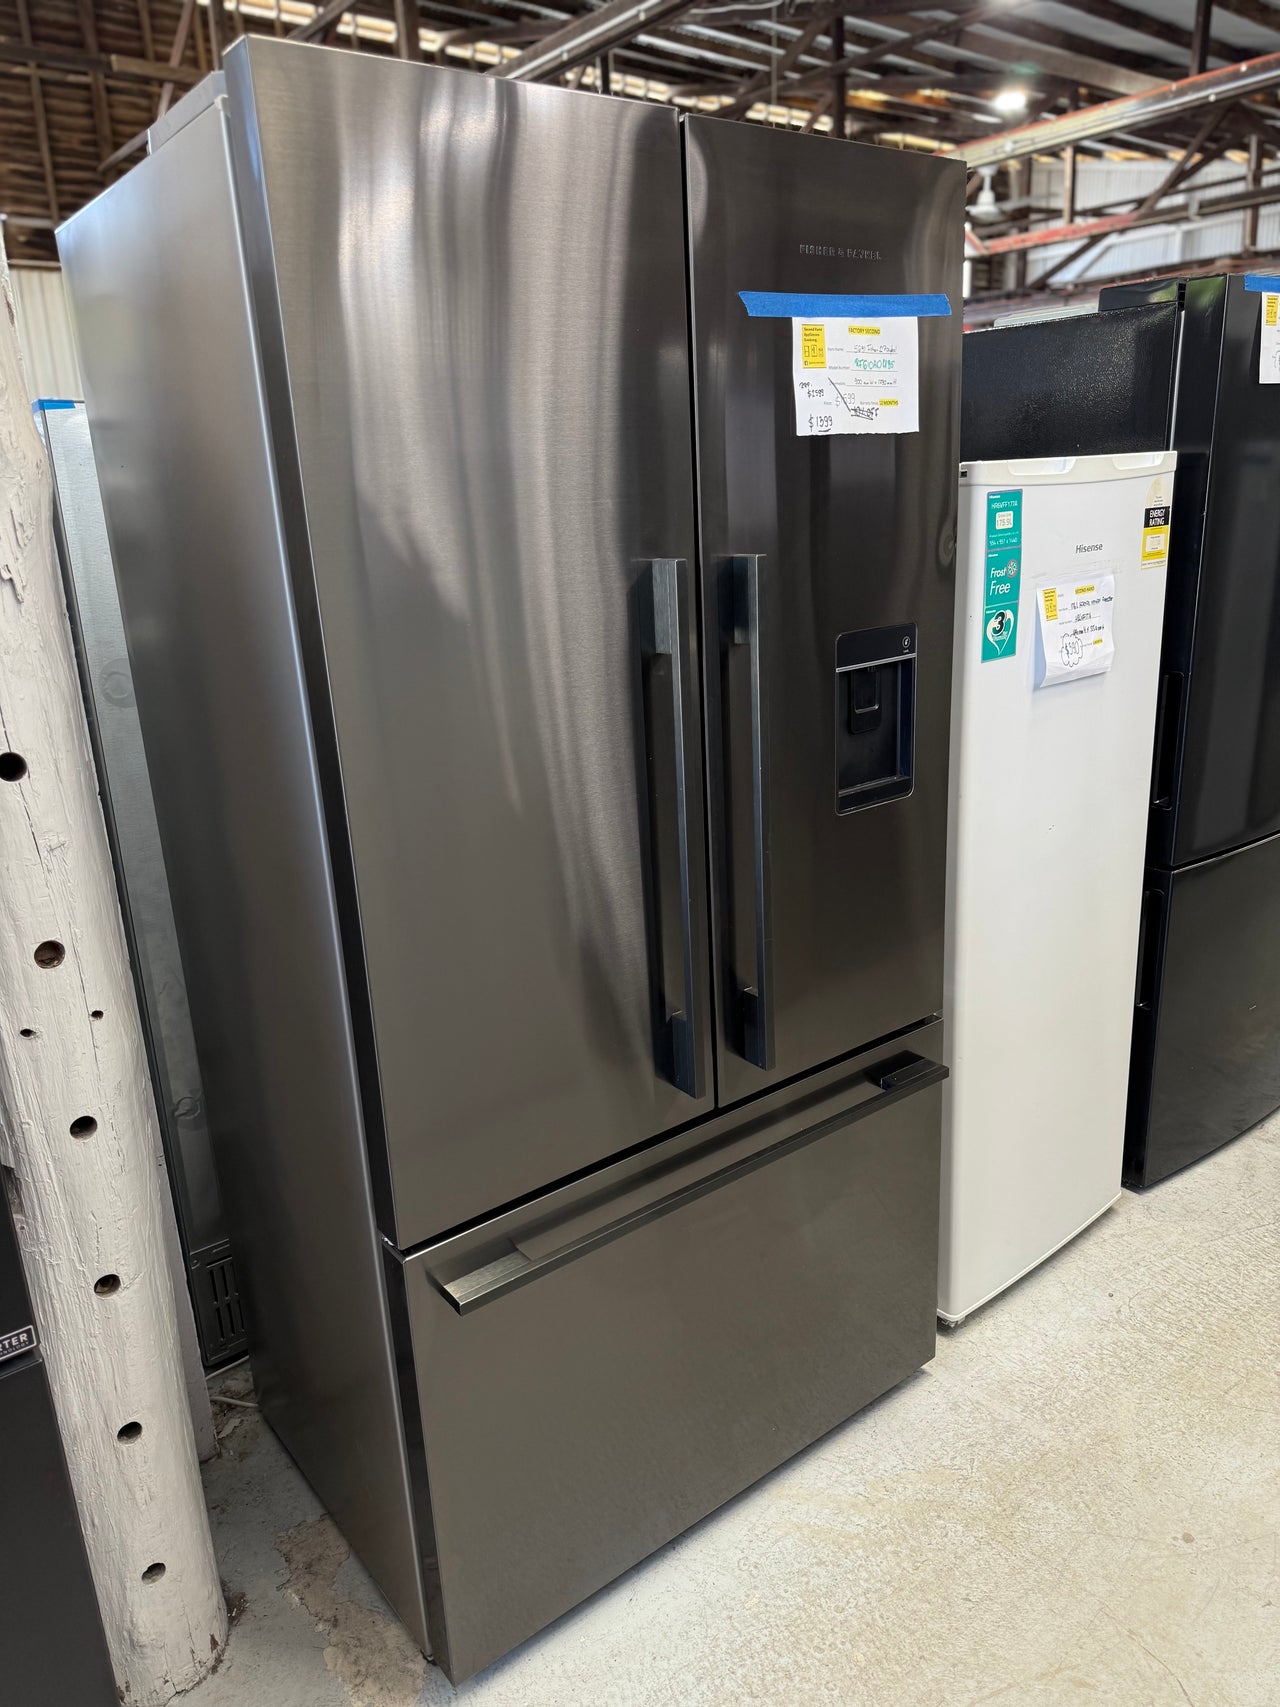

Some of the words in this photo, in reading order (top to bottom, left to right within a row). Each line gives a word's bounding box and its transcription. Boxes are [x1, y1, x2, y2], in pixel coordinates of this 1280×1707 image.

[799, 244, 836, 256] FISHER
[837, 247, 845, 258] &
[847, 248, 882, 260] PAYKEL
[1149, 508, 1166, 518] ENERGY
[1149, 517, 1165, 526] RATING
[1075, 543, 1103, 554] Hisense
[990, 567, 1007, 578] Frost
[989, 580, 1011, 596] Free
[990, 610, 1006, 636] 3
